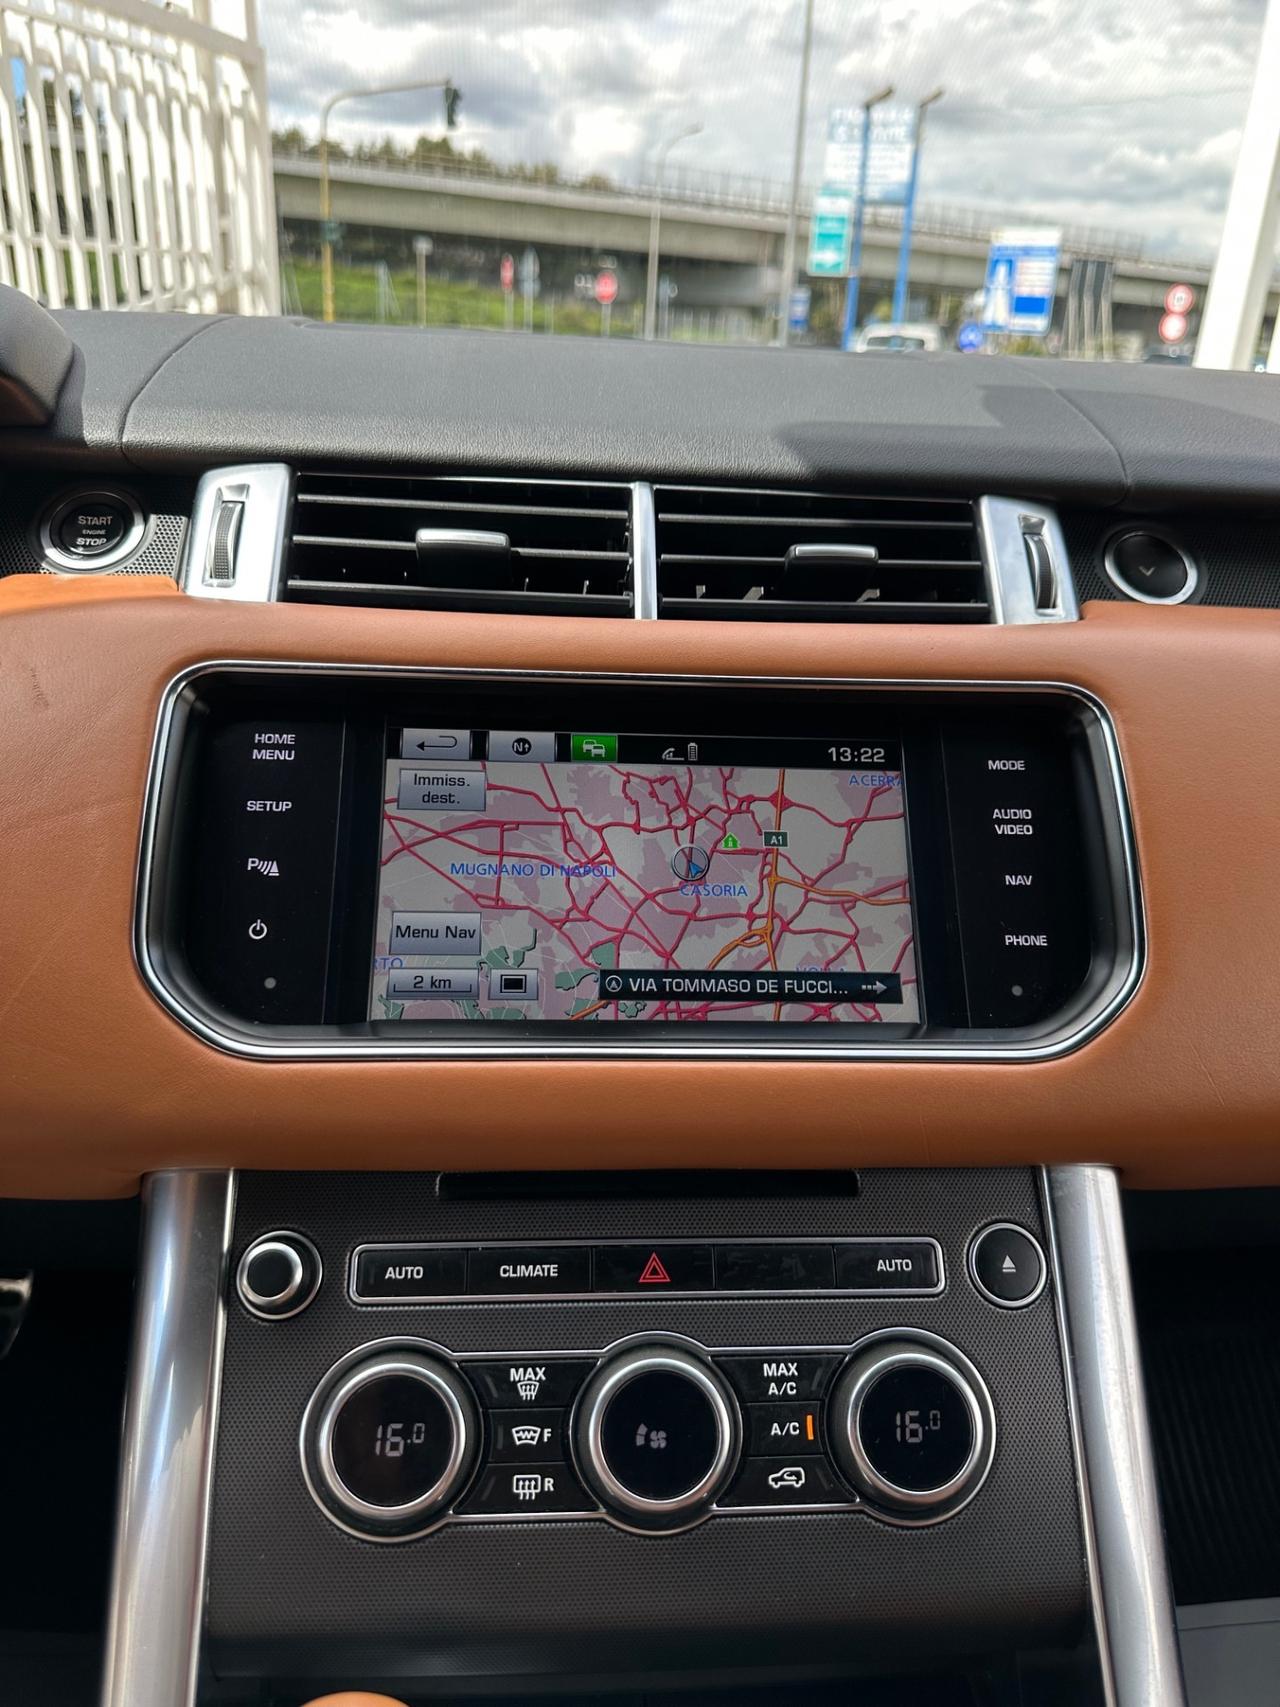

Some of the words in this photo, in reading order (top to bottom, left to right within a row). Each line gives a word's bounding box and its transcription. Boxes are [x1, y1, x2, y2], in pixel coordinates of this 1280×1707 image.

[78, 515, 113, 526] START
[76, 537, 107, 546] STOP
[254, 733, 296, 745] HOME
[252, 749, 295, 761] MENU
[828, 747, 886, 762] 13:22
[987, 759, 1026, 771] MODE
[413, 773, 471, 787] Immiss.
[421, 790, 460, 805] dest.
[246, 800, 292, 812] SETUP
[992, 808, 1032, 820] AUDIO
[994, 824, 1033, 835] VIDEO
[770, 834, 783, 845] A1
[450, 862, 535, 877] MUGNANO
[540, 863, 555, 877] DI
[559, 864, 617, 878] NAPOLI
[1005, 874, 1032, 886] NAV
[680, 884, 748, 897] CASORIA
[395, 925, 442, 939] Menu
[445, 925, 477, 939] Nav
[1005, 934, 1048, 946] PHONE
[413, 975, 424, 989] 2
[430, 975, 452, 989] km
[628, 977, 657, 992] VIA
[663, 978, 751, 993] TOMMASO
[757, 979, 778, 993] DE
[385, 1265, 424, 1280] AUTO
[499, 1264, 559, 1278] CLIMATE
[876, 1259, 912, 1272] AUTO
[509, 1367, 546, 1381] MAX
[763, 1363, 798, 1377] MAX
[768, 1381, 797, 1395] A/C
[543, 1428, 552, 1442] F
[770, 1422, 800, 1436] A/C
[374, 1422, 425, 1457] 16.0
[543, 1477, 554, 1491] R
